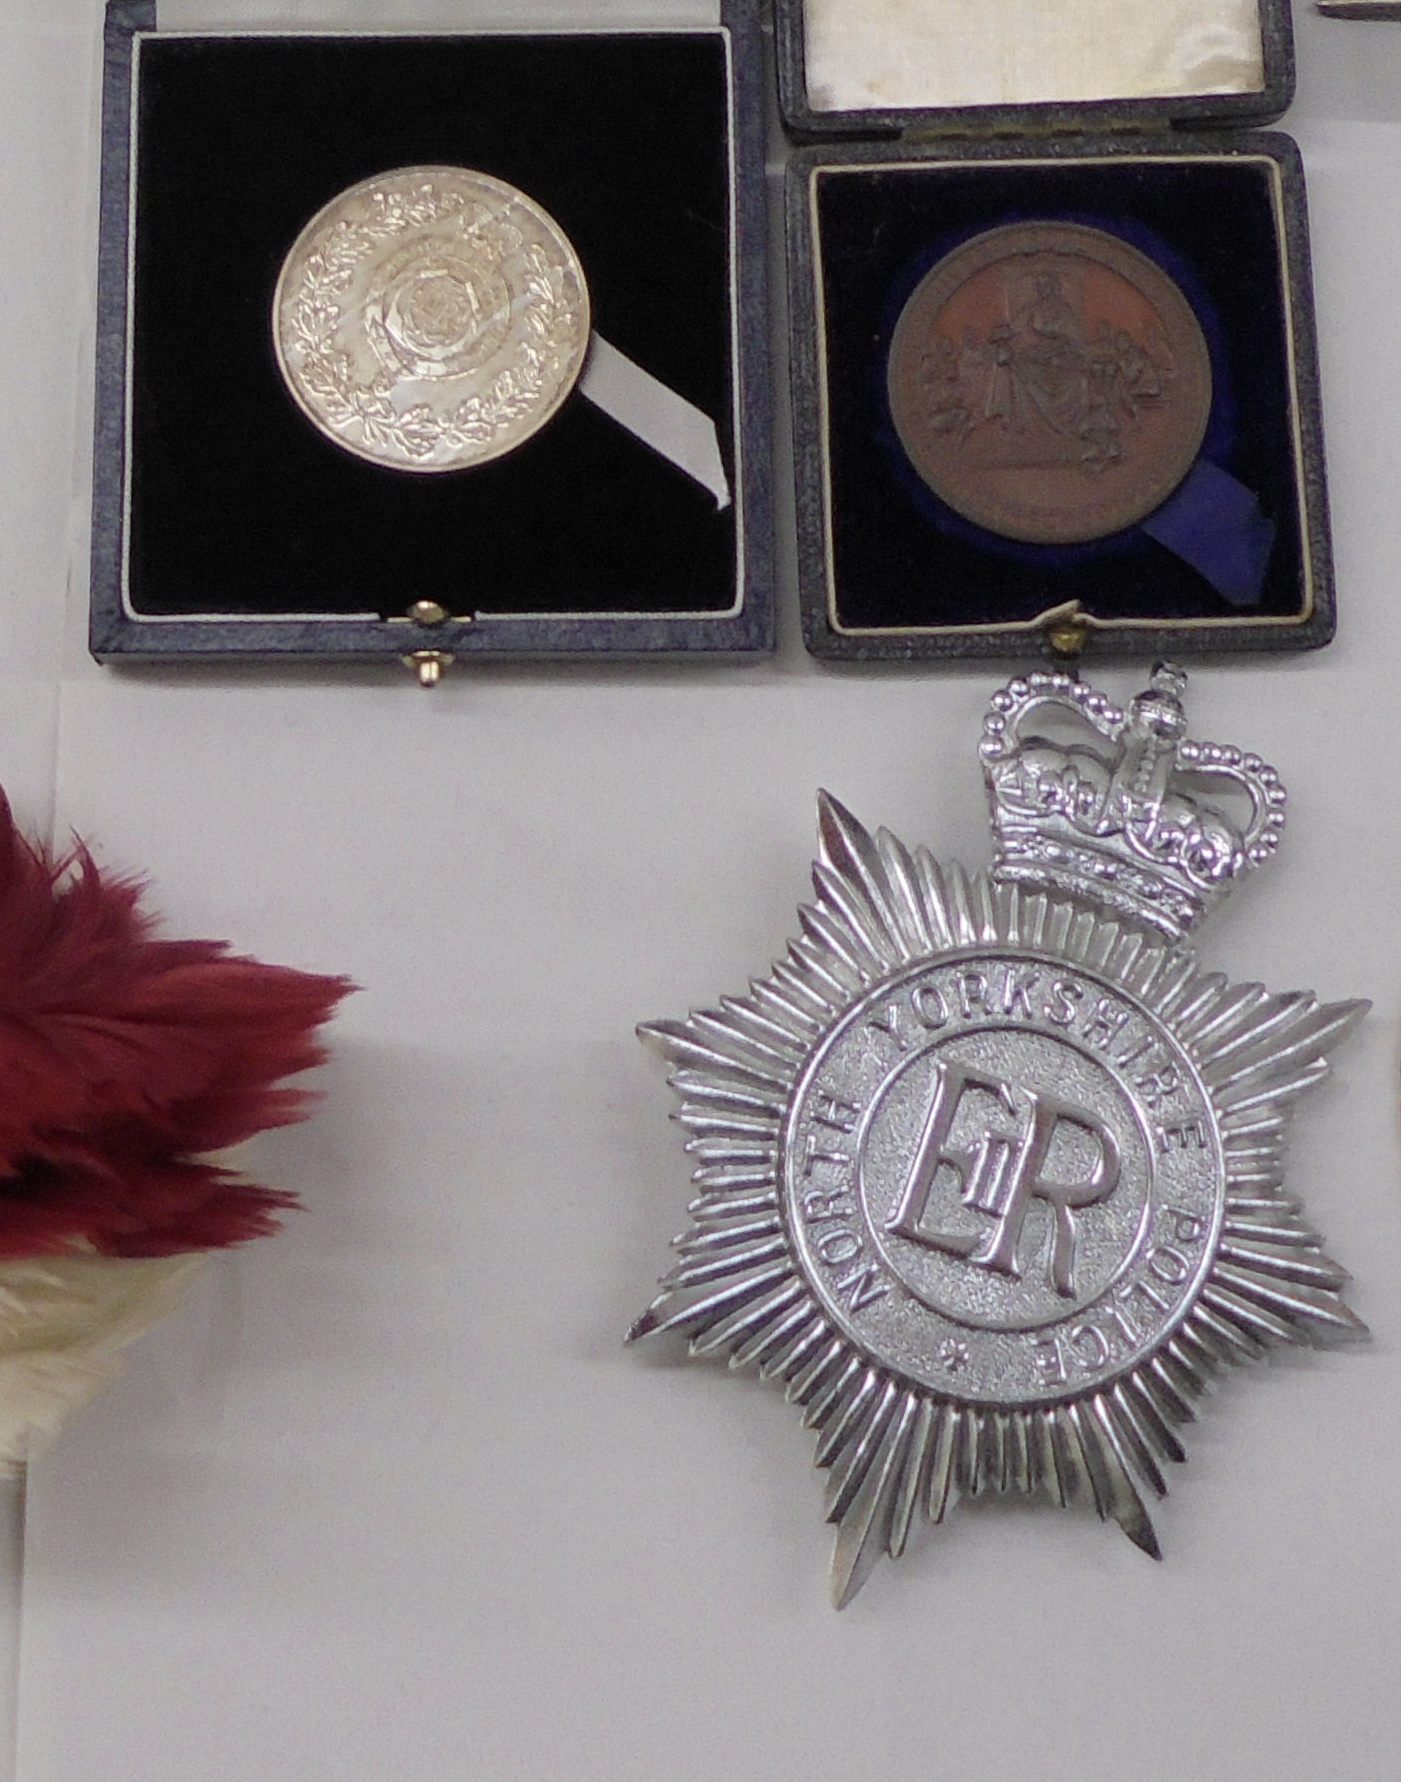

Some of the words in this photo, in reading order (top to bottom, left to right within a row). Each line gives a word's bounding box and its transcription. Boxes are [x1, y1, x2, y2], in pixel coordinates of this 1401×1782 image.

[867, 968, 1209, 1154] YORKSHIRE
[803, 1076, 888, 1313] NORTH
[1034, 1203, 1206, 1388] POLICE
